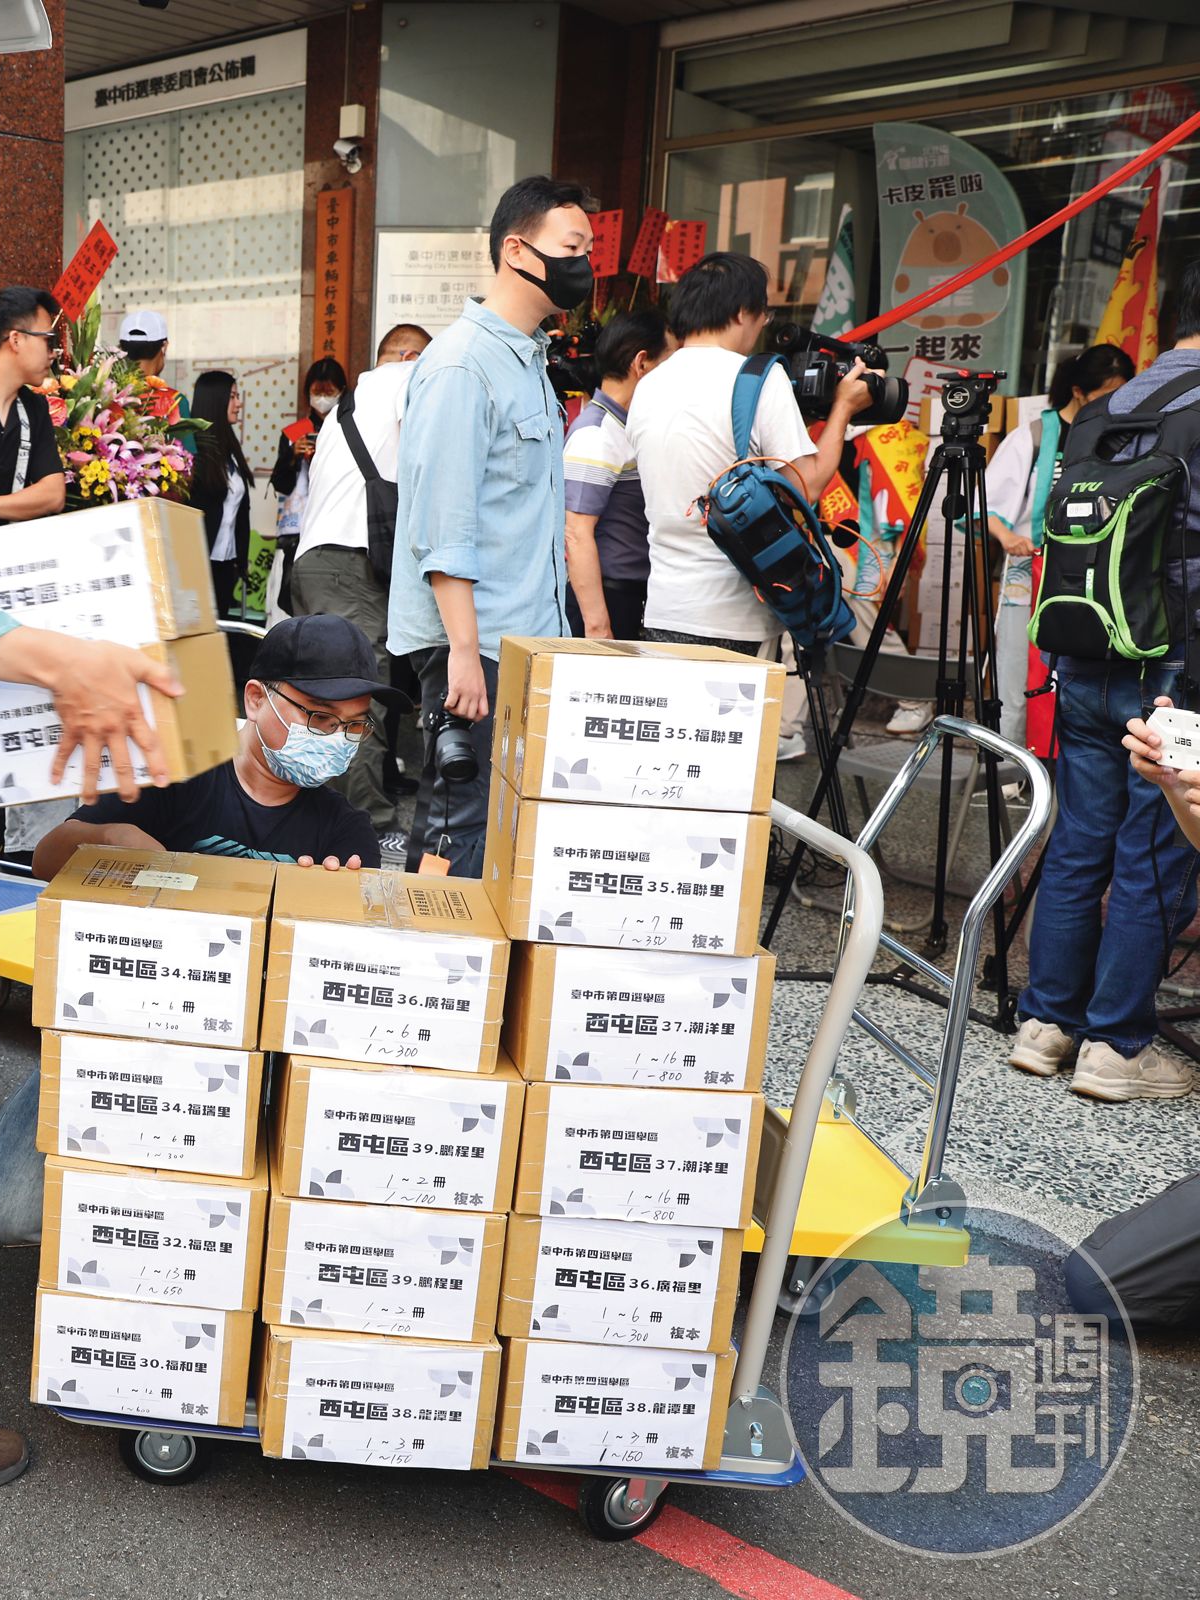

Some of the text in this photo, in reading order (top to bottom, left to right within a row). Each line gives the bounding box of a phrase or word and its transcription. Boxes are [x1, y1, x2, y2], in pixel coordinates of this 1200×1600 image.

[94, 55, 256, 108] 臺中市選舉委員會公佈欄
[882, 174, 984, 205] 卡皮罷啦
[883, 333, 982, 361] 一起來
[1071, 481, 1103, 493] TVU
[569, 691, 668, 708] 臺中市第四選舉區
[554, 846, 650, 862] 臺中市第四選舉區
[74, 931, 163, 949] 臺中市第四選舉區
[692, 934, 724, 949] 複本
[309, 957, 400, 976] 臺中市第四選舉區
[571, 989, 665, 1003] 臺中市第四選舉區
[203, 1017, 232, 1032] 複本
[77, 1068, 163, 1085] 臺中市第四選舉區
[704, 1070, 734, 1085] 複本
[324, 1109, 416, 1126] 臺中市第四選舉區
[565, 1128, 658, 1142] 臺中市第四選舉區
[454, 1192, 484, 1206] 複本
[78, 1203, 164, 1220] 臺中市第四選舉區
[305, 1241, 394, 1257] 臺中市第四選舉區
[541, 1246, 632, 1262] 臺中市第四選舉區
[57, 1325, 142, 1342] 臺中市第四選舉區
[670, 1327, 700, 1341] 複本
[306, 1378, 394, 1392] 臺中市第四選舉區
[541, 1375, 630, 1387] 臺中市第四選舉區
[181, 1403, 208, 1415] 複本
[666, 1447, 694, 1459] 複本
